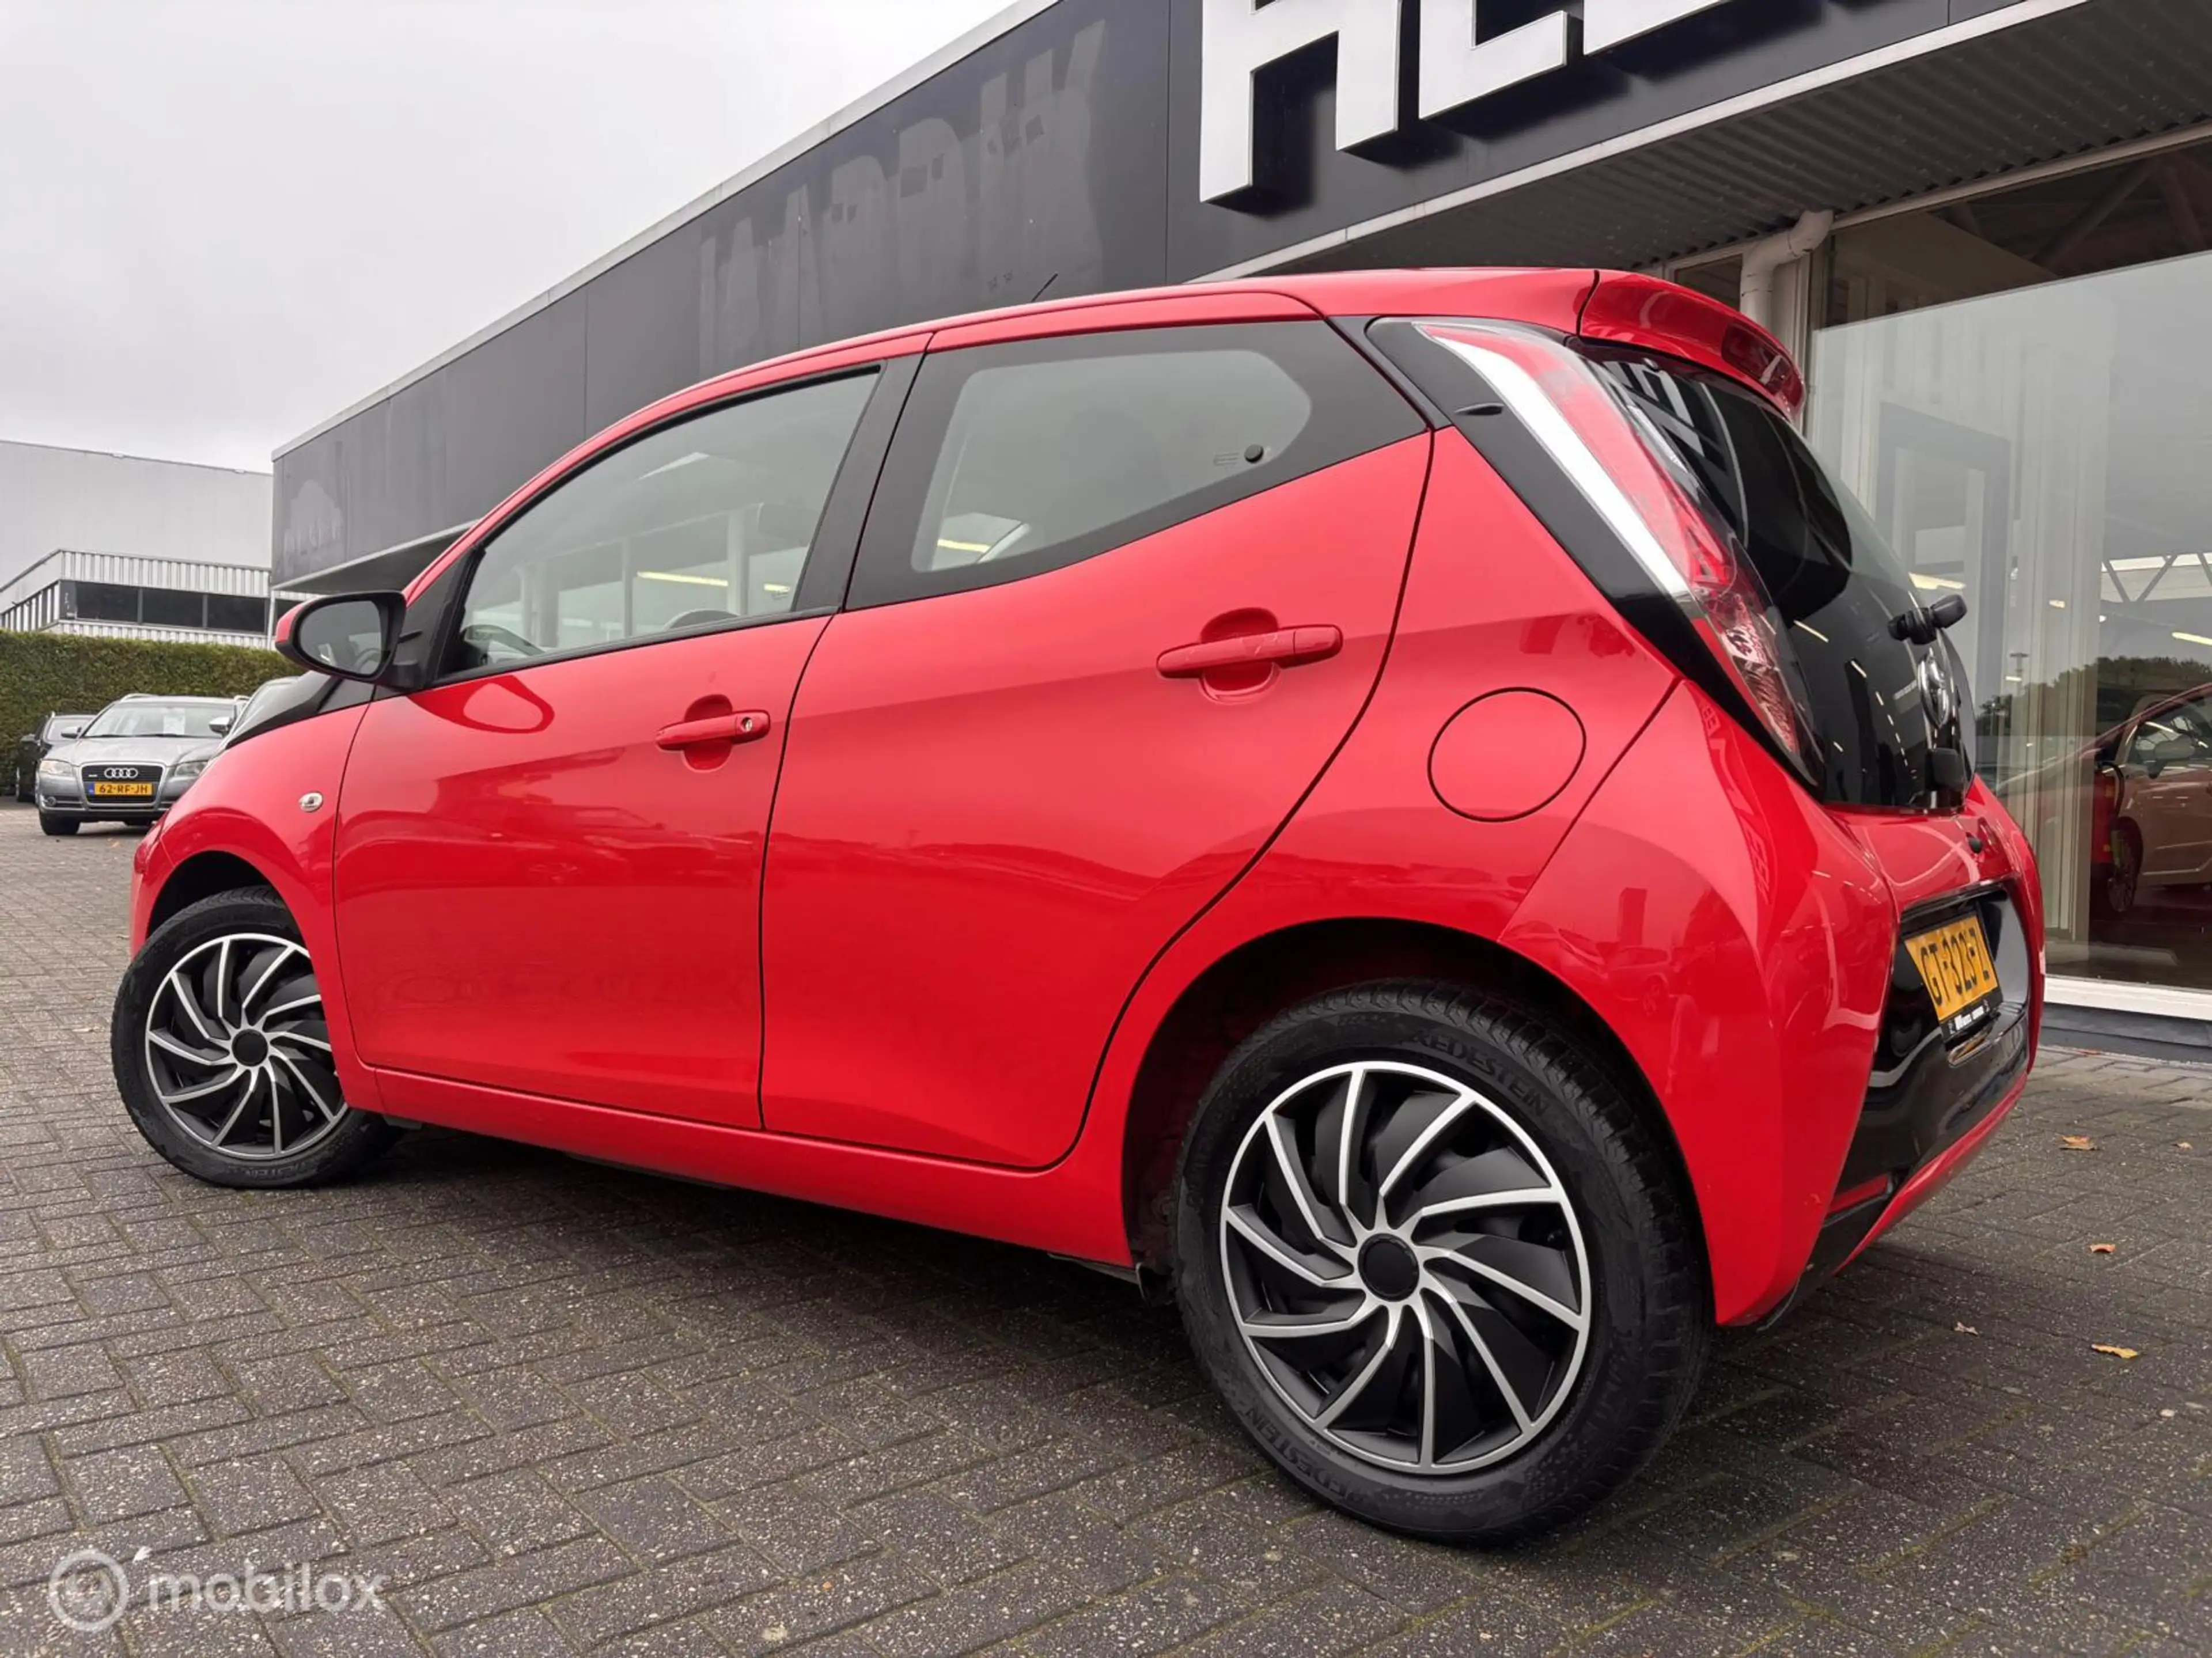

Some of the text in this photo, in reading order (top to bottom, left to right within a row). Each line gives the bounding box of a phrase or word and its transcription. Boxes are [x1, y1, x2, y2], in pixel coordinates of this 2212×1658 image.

[99, 784, 147, 794] 62-RF-JH
[1920, 927, 1990, 1006] GT-323-Z
[1407, 1029, 1550, 1116] REDESTEIN
[1244, 1406, 1366, 1504] EDESTEIN
